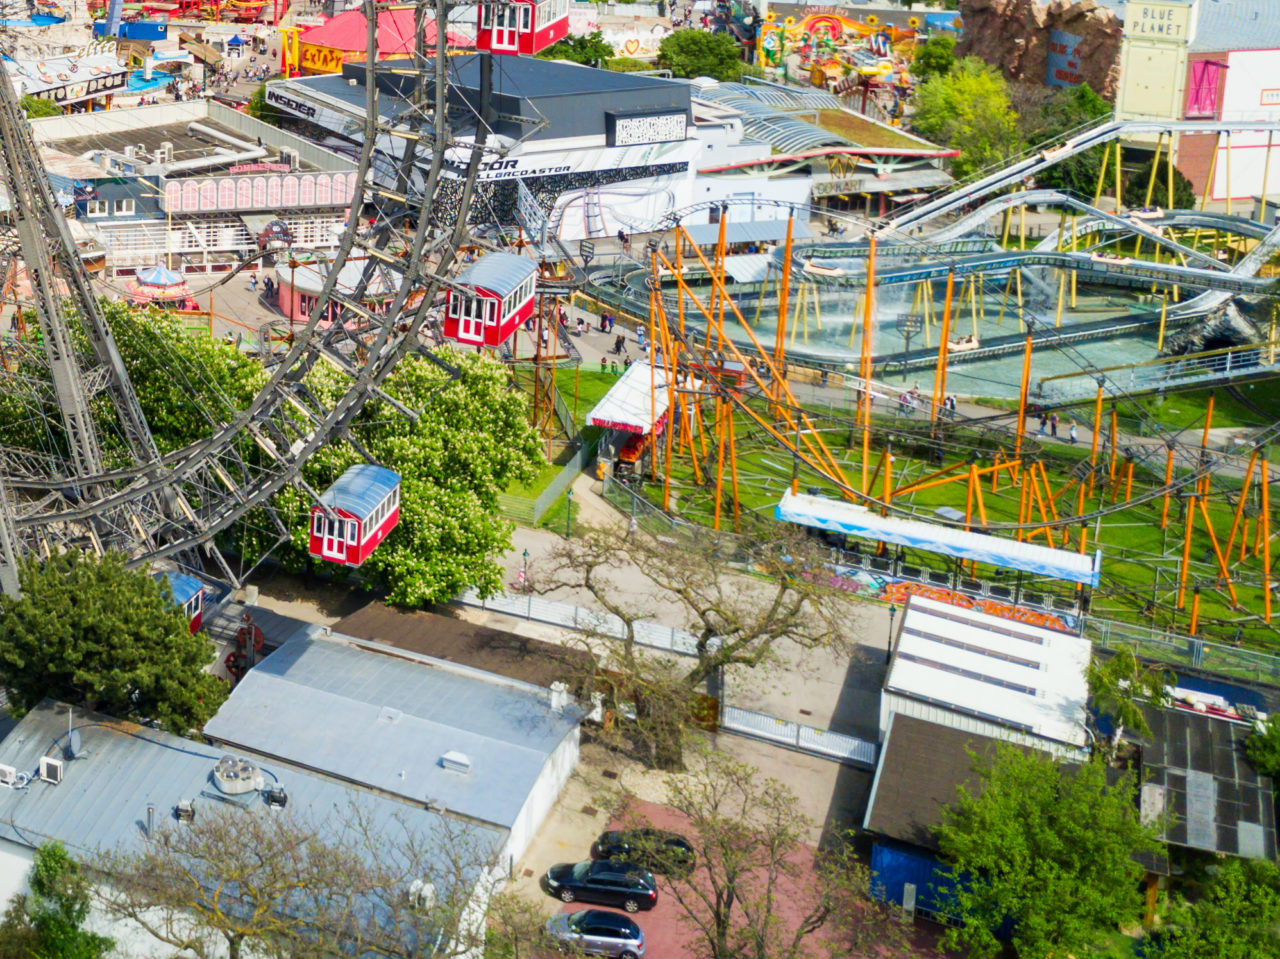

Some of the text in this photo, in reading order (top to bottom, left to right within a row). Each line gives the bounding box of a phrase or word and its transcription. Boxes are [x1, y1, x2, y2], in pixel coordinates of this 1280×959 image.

[1143, 7, 1173, 20] BLUE
[1132, 21, 1182, 35] PLANET
[267, 90, 316, 118] INSIDER
